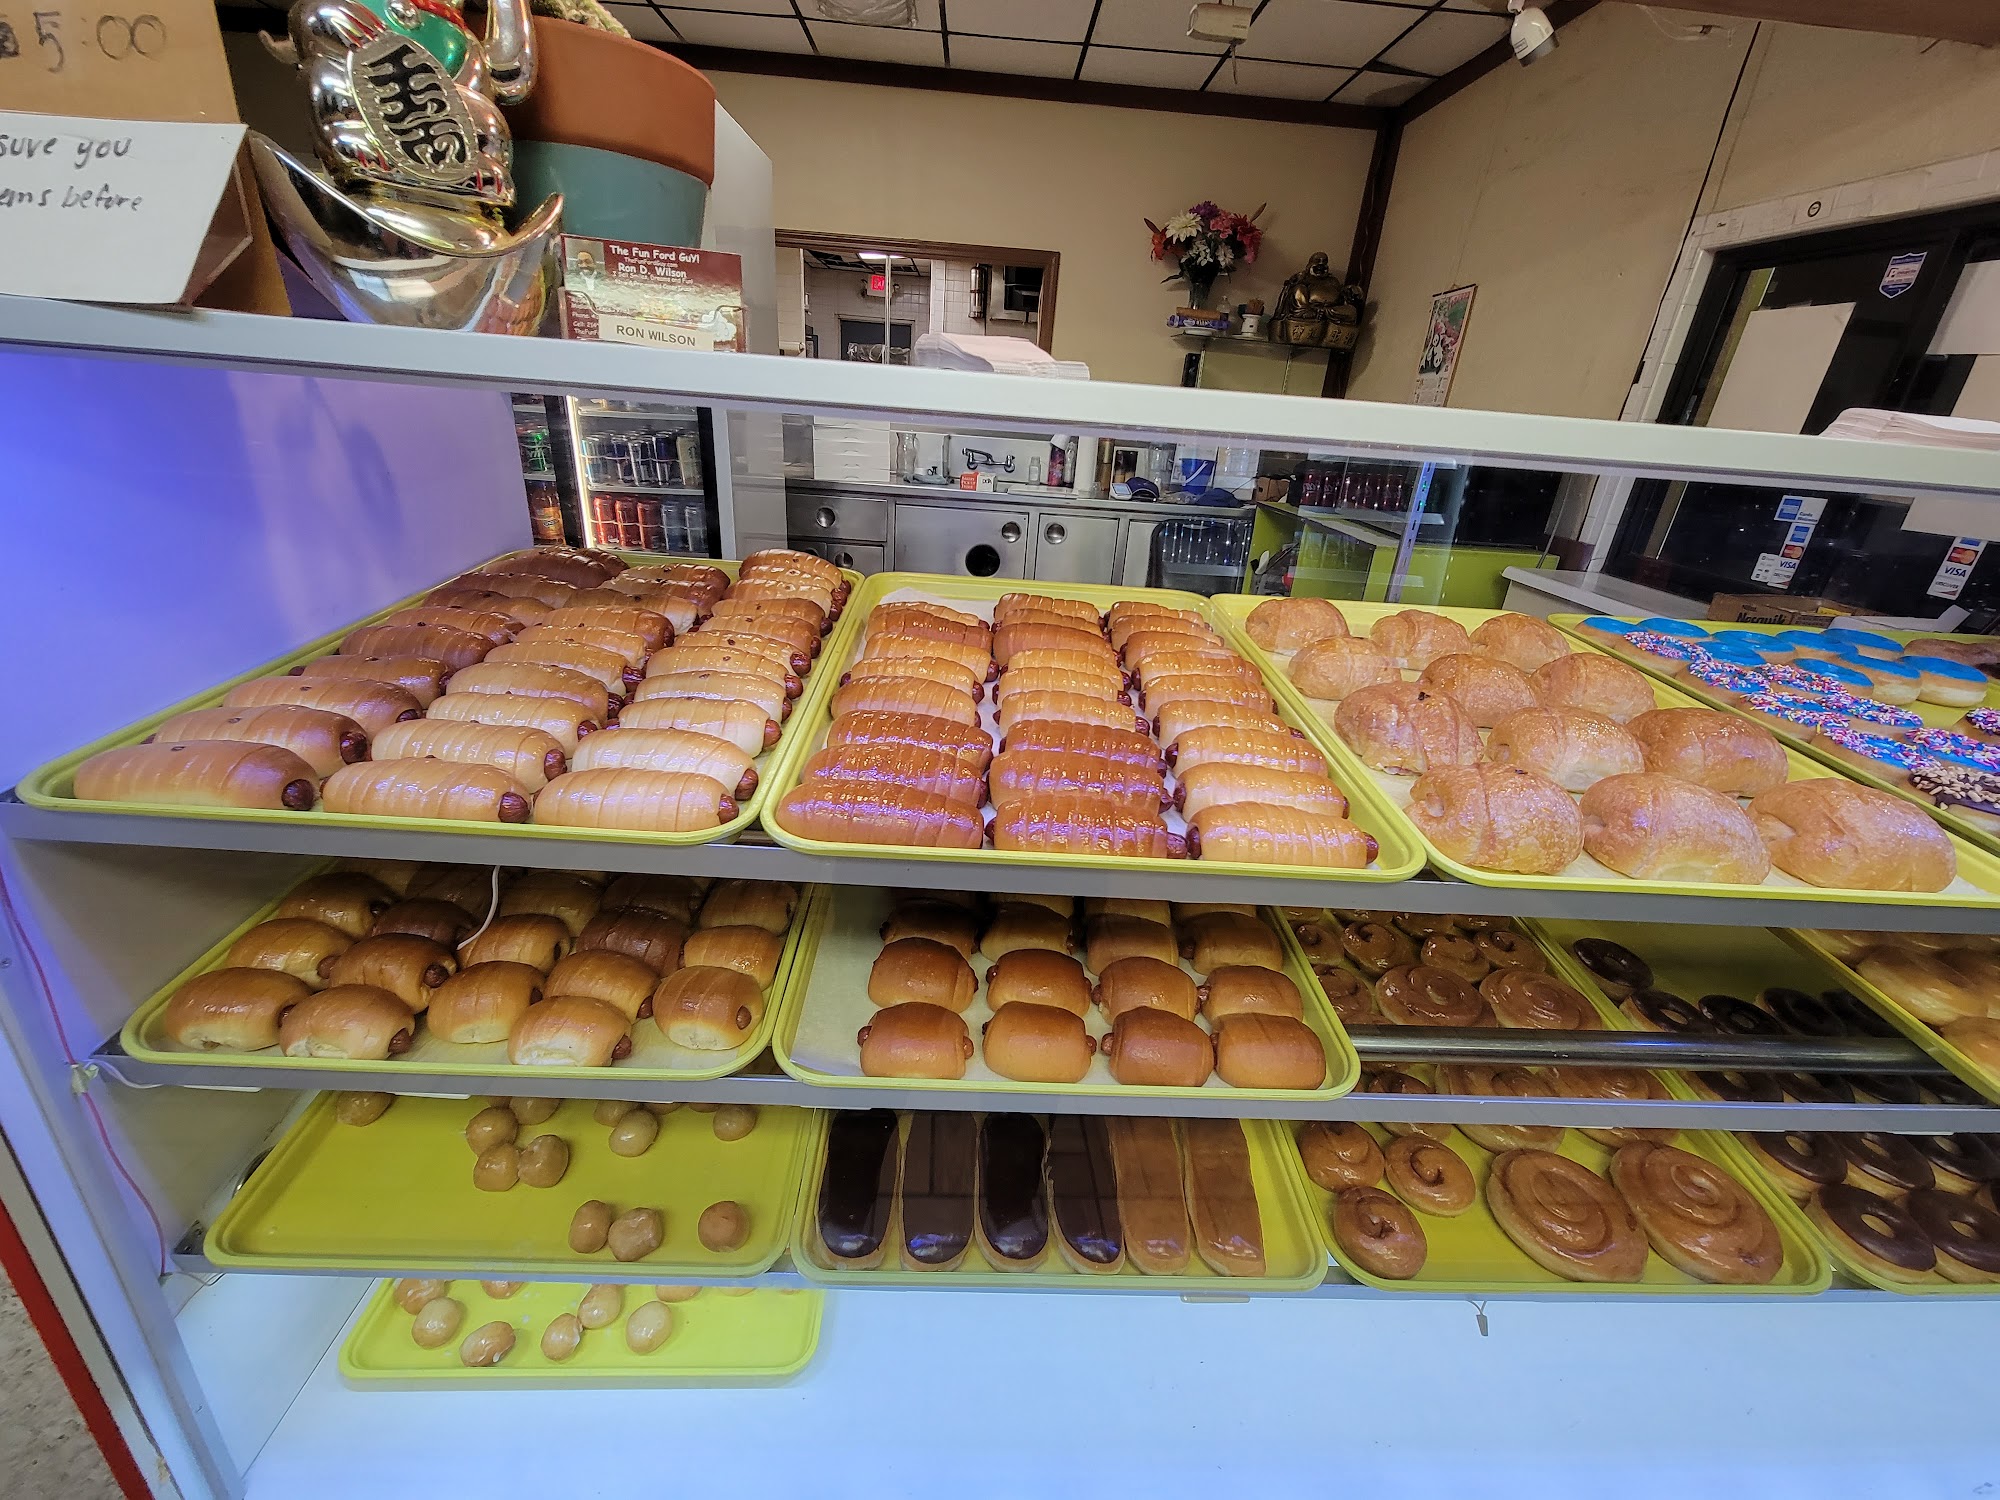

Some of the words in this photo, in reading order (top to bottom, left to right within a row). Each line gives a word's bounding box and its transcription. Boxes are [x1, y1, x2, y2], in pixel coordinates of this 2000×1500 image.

[74, 137, 133, 169] you
[61, 183, 143, 211] before
[609, 245, 629, 256] The
[632, 247, 650, 258] Fun
[653, 249, 675, 261] Ford
[618, 262, 637, 273] Ron
[640, 264, 651, 275] D.
[655, 266, 687, 278] Wilson
[616, 325, 645, 339] RON
[648, 330, 696, 347] WILSON
[1779, 560, 1797, 570] VISA
[1944, 566, 1967, 577] VISA
